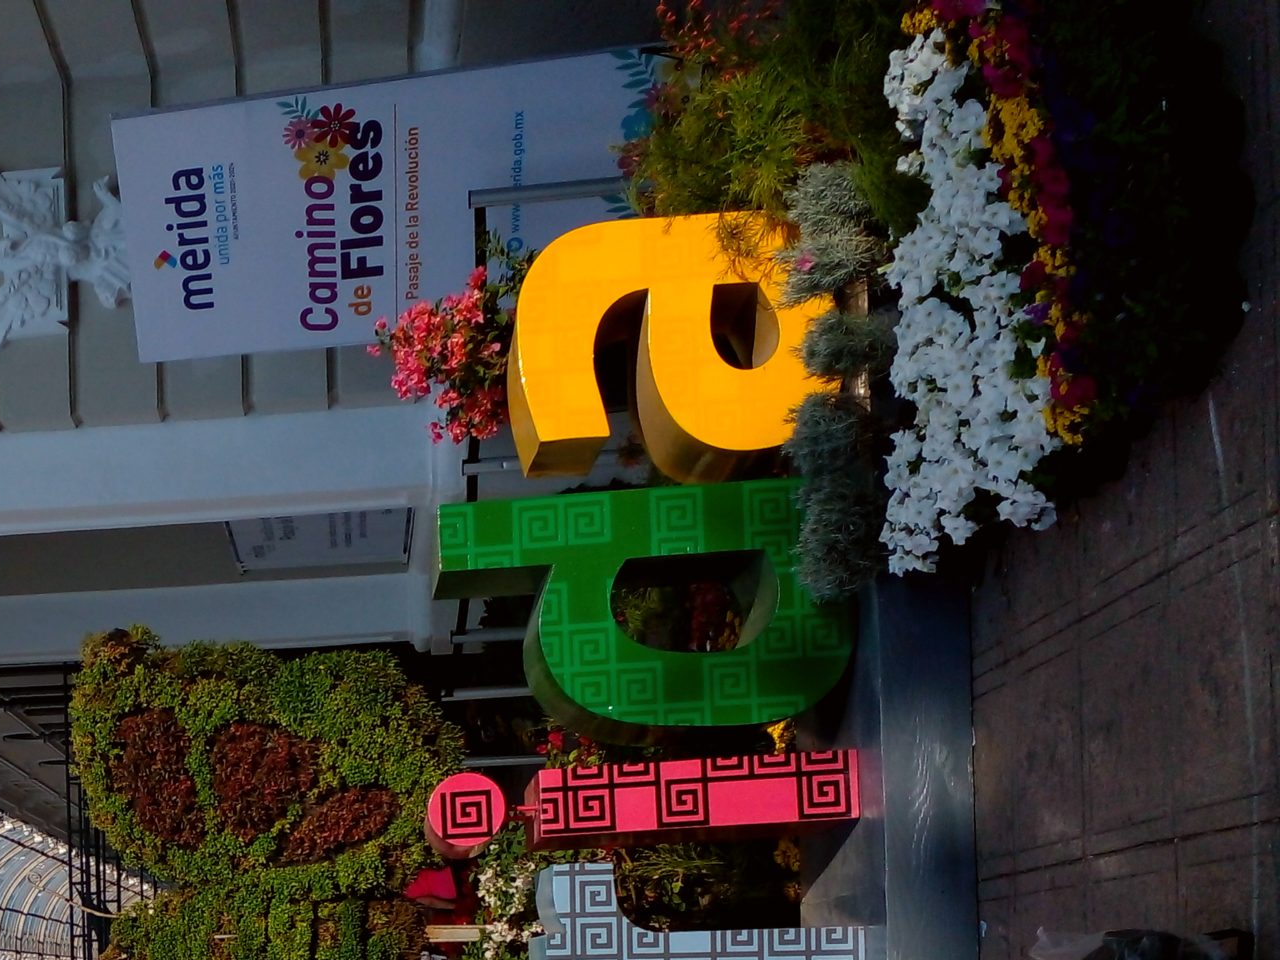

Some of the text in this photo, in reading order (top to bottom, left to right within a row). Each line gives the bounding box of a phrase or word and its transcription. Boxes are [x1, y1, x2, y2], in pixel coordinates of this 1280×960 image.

[154, 167, 214, 311] mérida
[209, 164, 230, 265] unida por más
[294, 175, 339, 332] Camino
[340, 119, 384, 316] de Flores
[404, 127, 421, 300] Pasaje de la Revolución
